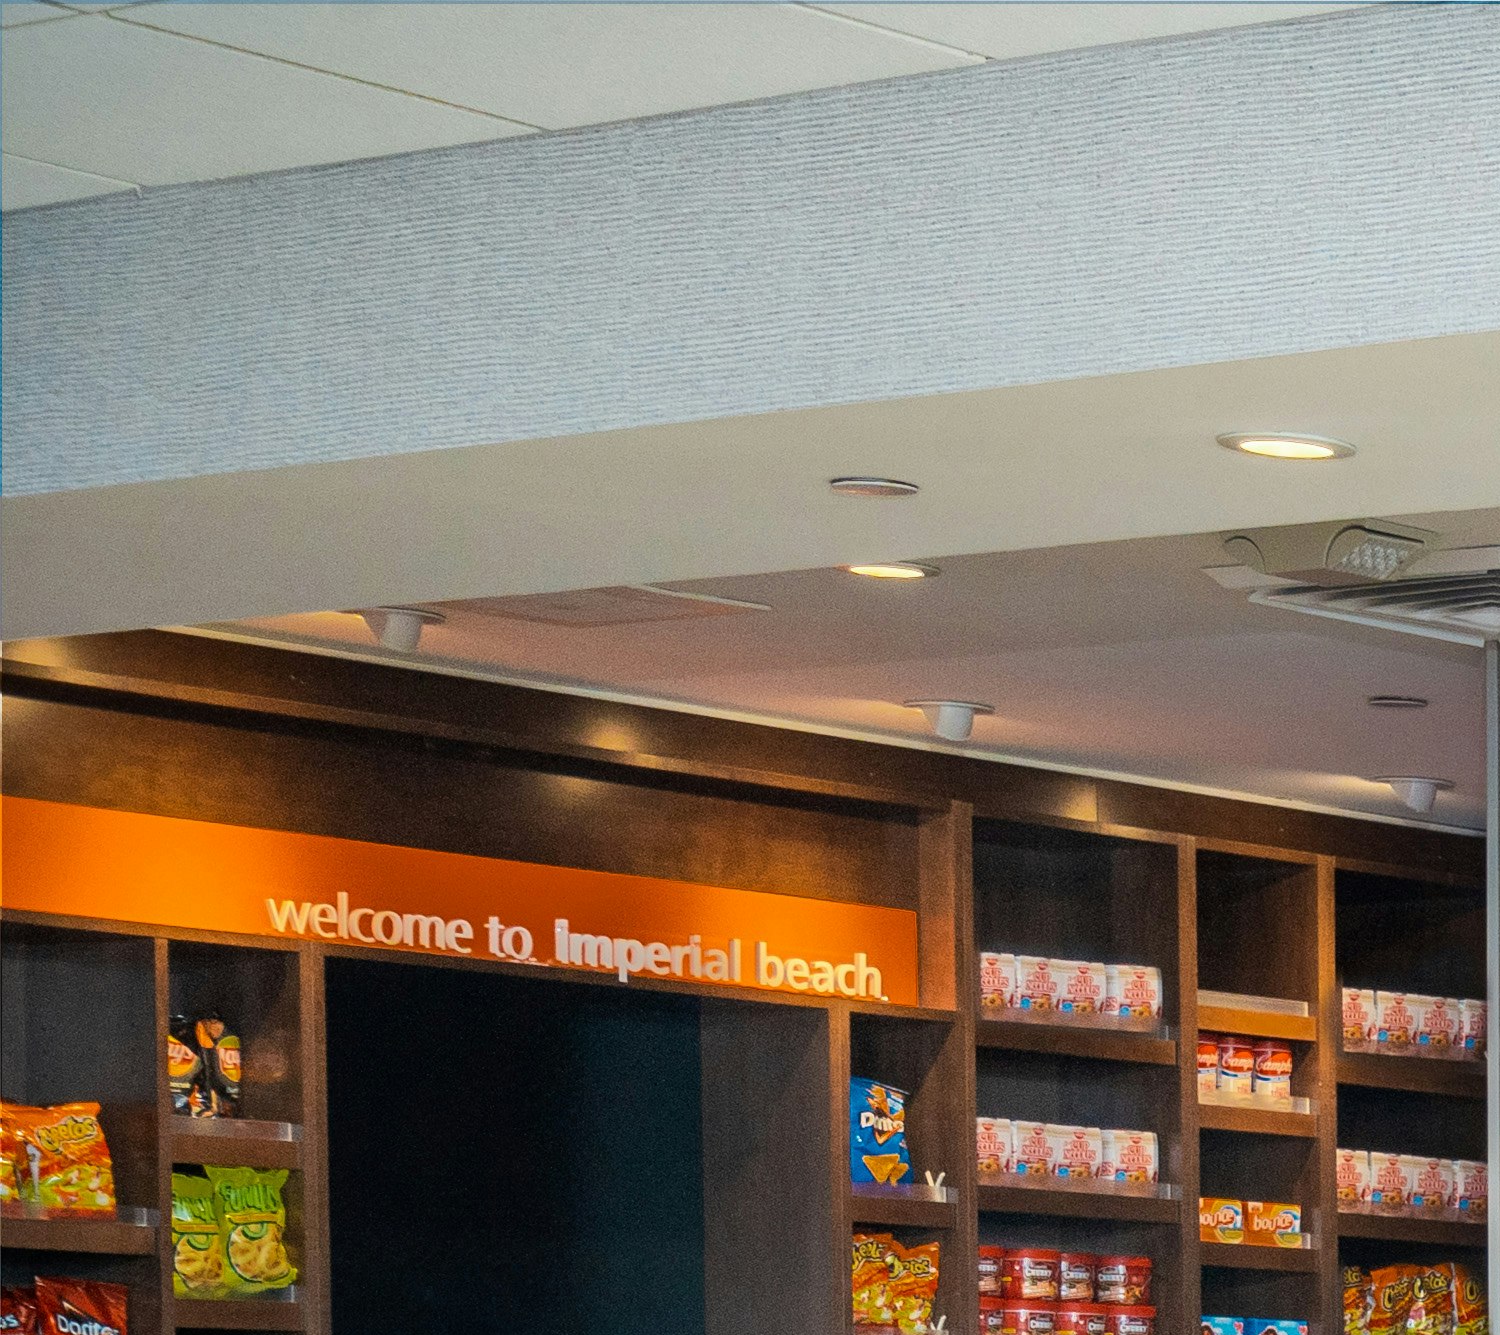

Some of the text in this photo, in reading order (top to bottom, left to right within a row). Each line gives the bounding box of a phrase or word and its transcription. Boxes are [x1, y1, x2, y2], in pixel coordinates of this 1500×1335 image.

[265, 892, 472, 955] welcome
[484, 916, 533, 960] to
[755, 941, 882, 998] beach
[1200, 1212, 1235, 1226] ounce
[1253, 1214, 1293, 1231] bounce
